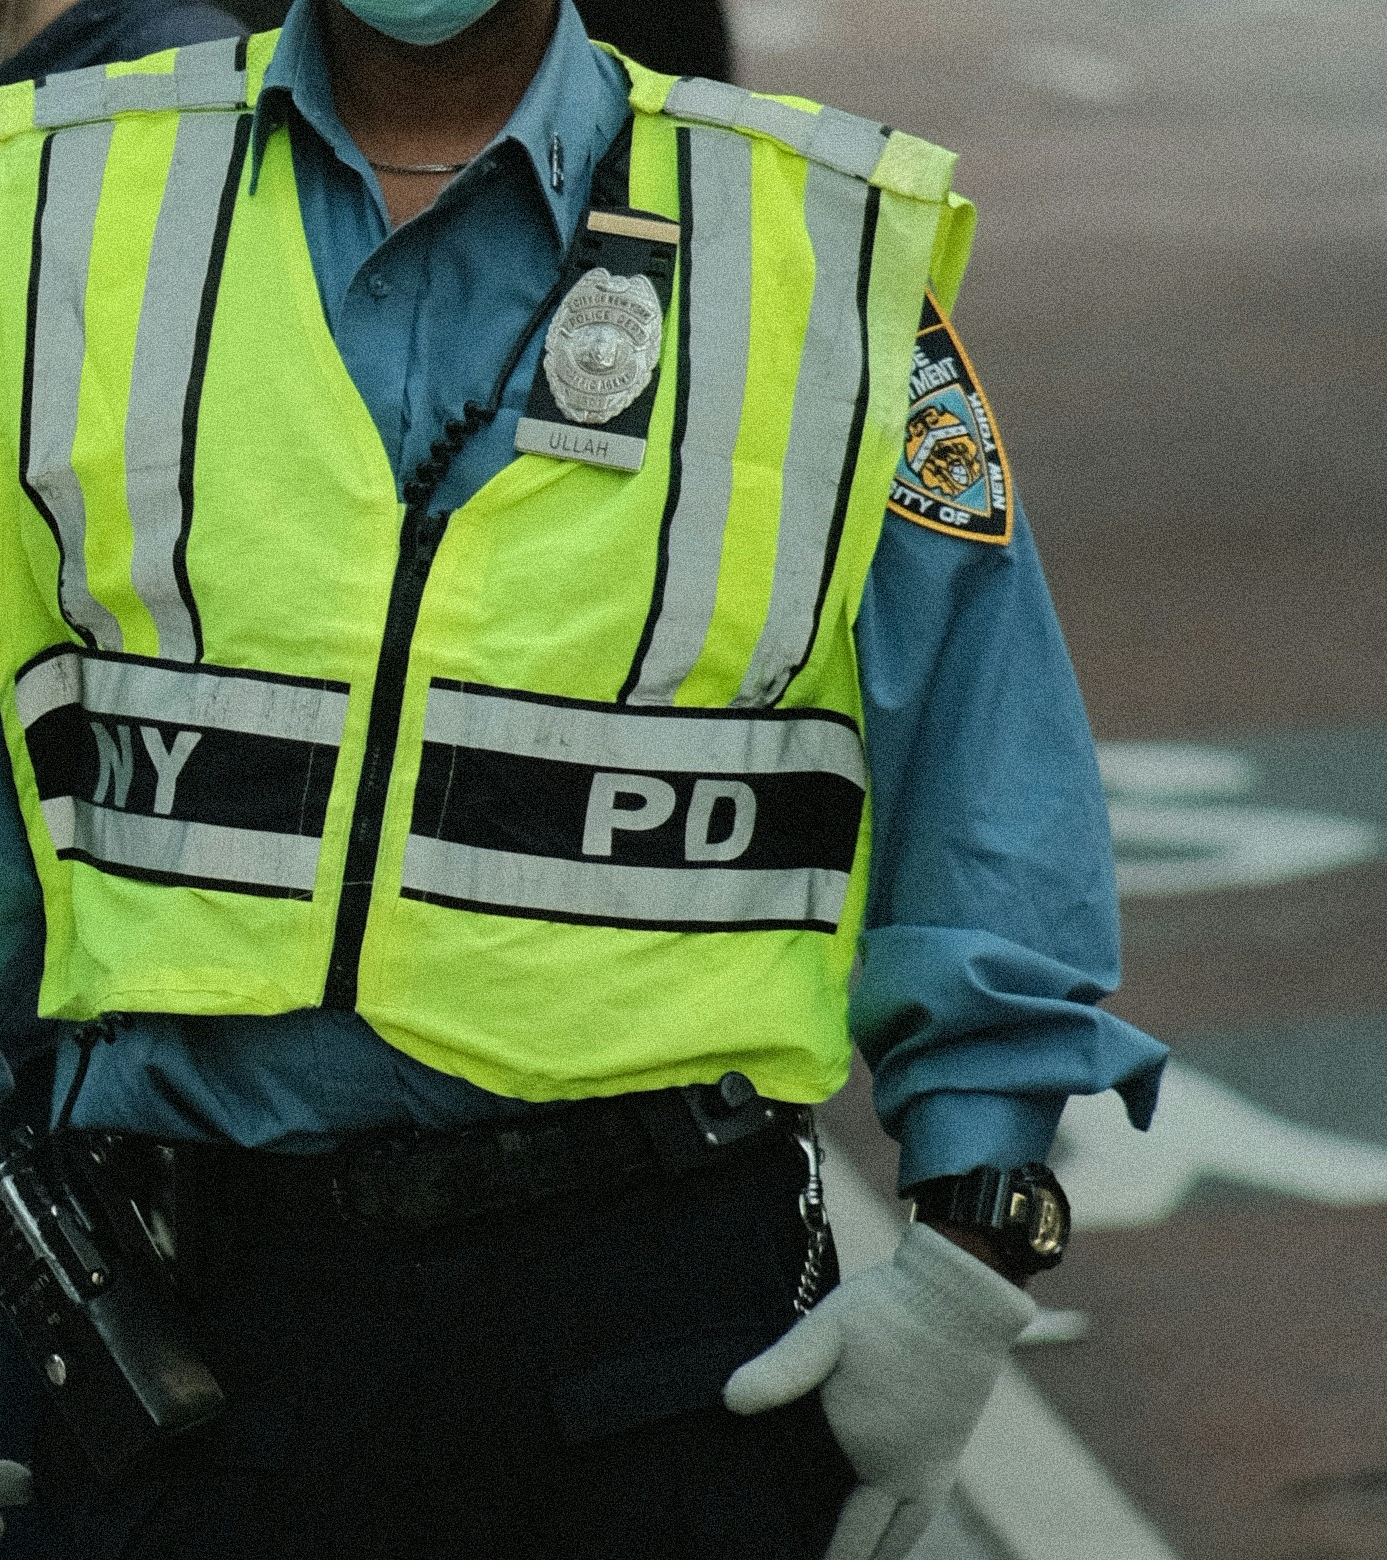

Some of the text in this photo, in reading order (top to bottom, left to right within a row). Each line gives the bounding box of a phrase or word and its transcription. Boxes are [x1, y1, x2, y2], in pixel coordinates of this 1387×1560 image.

[608, 295, 628, 307] NEW
[630, 302, 651, 320] YORK
[569, 310, 646, 341] POLICE DEPT
[548, 431, 609, 458] ULLAH
[968, 391, 1007, 511] NEW YORK
[938, 505, 972, 526] OF
[89, 721, 758, 863] NY PD
